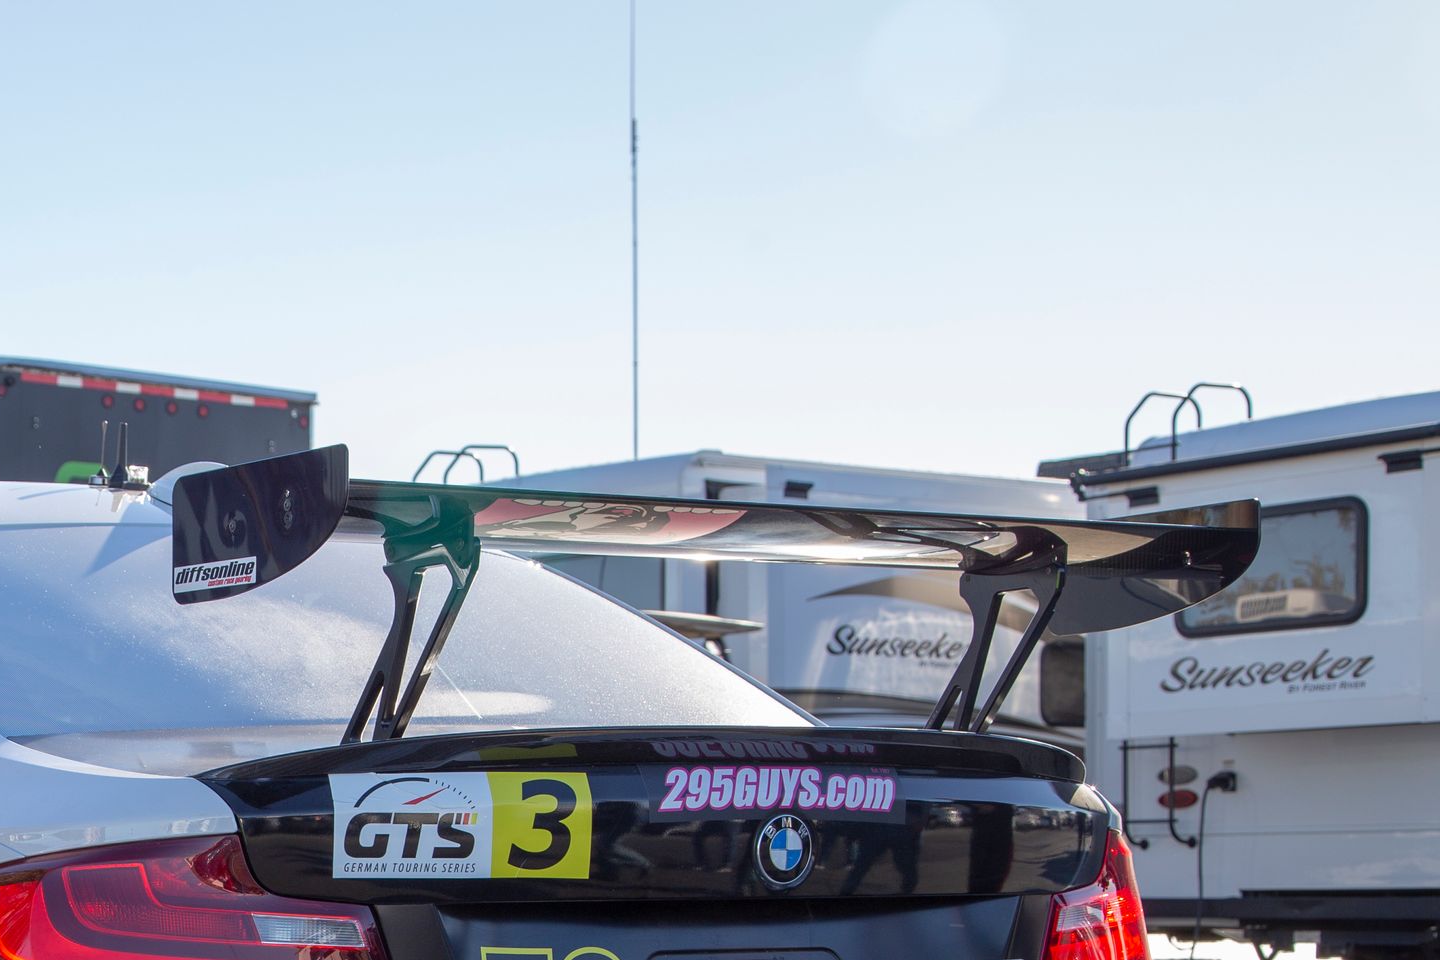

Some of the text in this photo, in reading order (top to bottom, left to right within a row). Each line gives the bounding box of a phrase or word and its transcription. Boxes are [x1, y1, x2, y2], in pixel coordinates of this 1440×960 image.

[175, 561, 255, 585] diffsonline
[826, 624, 967, 660] Sunseeke
[1160, 648, 1375, 693] Sunseeker
[658, 765, 896, 812] 295GUYS.com
[344, 812, 476, 859] GTS
[507, 778, 577, 871] 3
[343, 862, 477, 873] GERMAN TOURING SERIES
